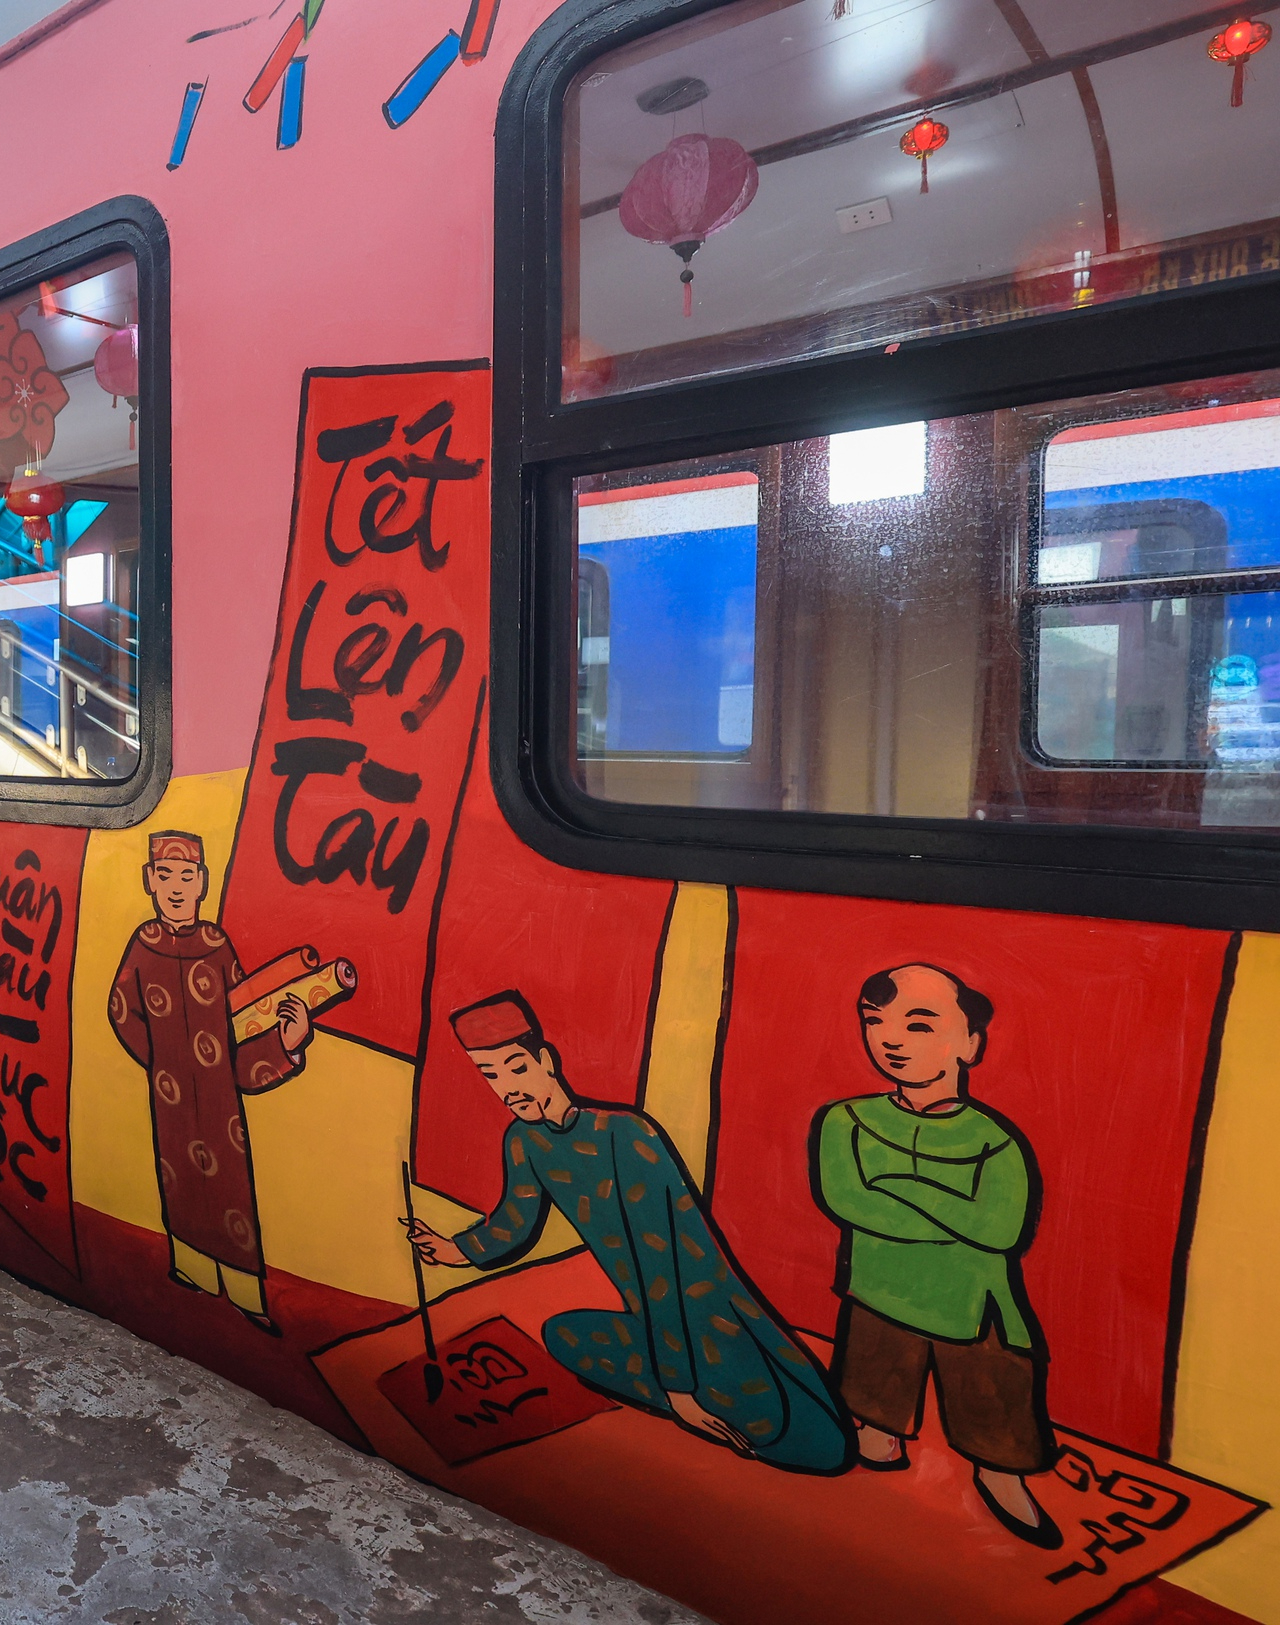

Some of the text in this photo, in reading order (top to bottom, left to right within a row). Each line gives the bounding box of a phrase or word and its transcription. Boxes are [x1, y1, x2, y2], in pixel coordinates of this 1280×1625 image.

[317, 400, 485, 572] Tết
[285, 579, 464, 733] Lên
[270, 736, 430, 914] Tàu
